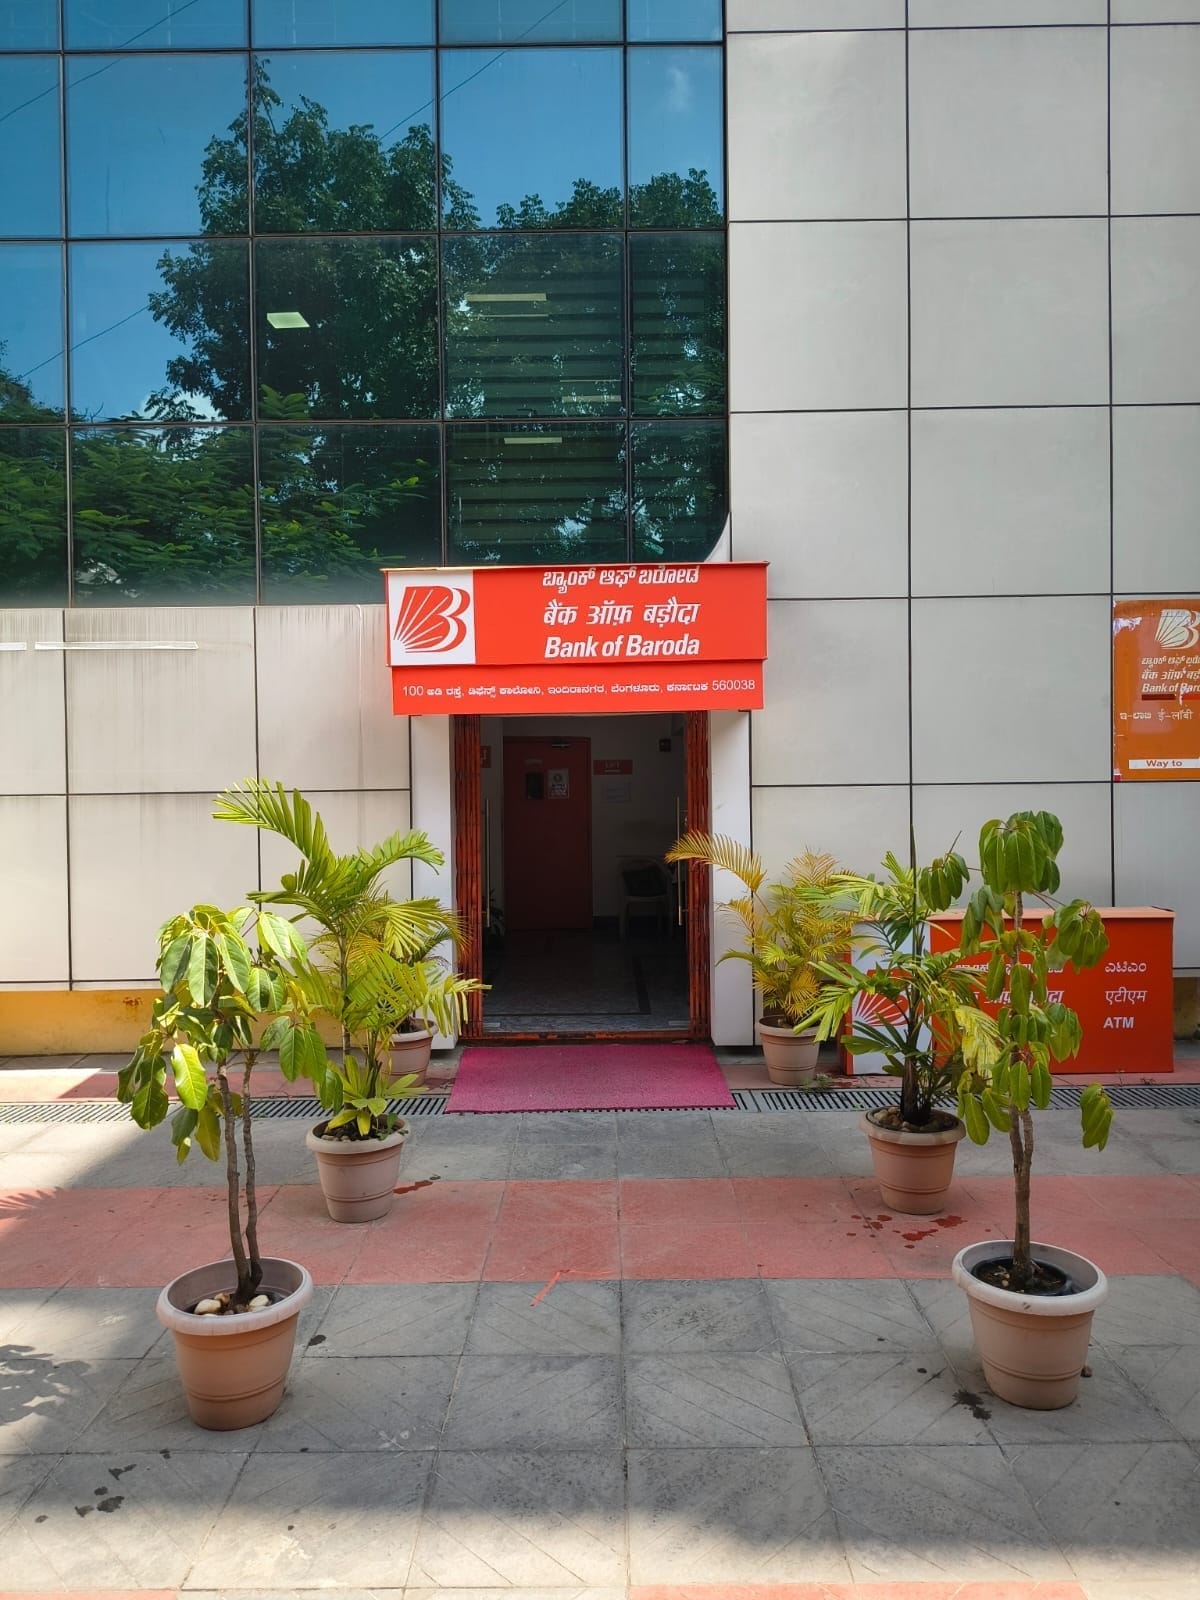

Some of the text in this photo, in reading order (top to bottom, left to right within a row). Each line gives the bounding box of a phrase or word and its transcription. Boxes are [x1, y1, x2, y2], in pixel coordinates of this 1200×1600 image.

[542, 567, 596, 594] ಬ್ಯಾಂಕ್
[599, 566, 637, 588] ಆಫ್
[543, 599, 579, 626] बैंक
[643, 596, 701, 628] बड़ौदा
[544, 633, 701, 658] Bank of Baroda
[402, 685, 424, 696] 100
[712, 679, 756, 691] 560038
[1142, 683, 1168, 693] Bank
[1168, 682, 1179, 692] of
[1145, 759, 1183, 768] Way to
[1105, 986, 1148, 1005] एटीएम
[1103, 1016, 1135, 1029] ATM
